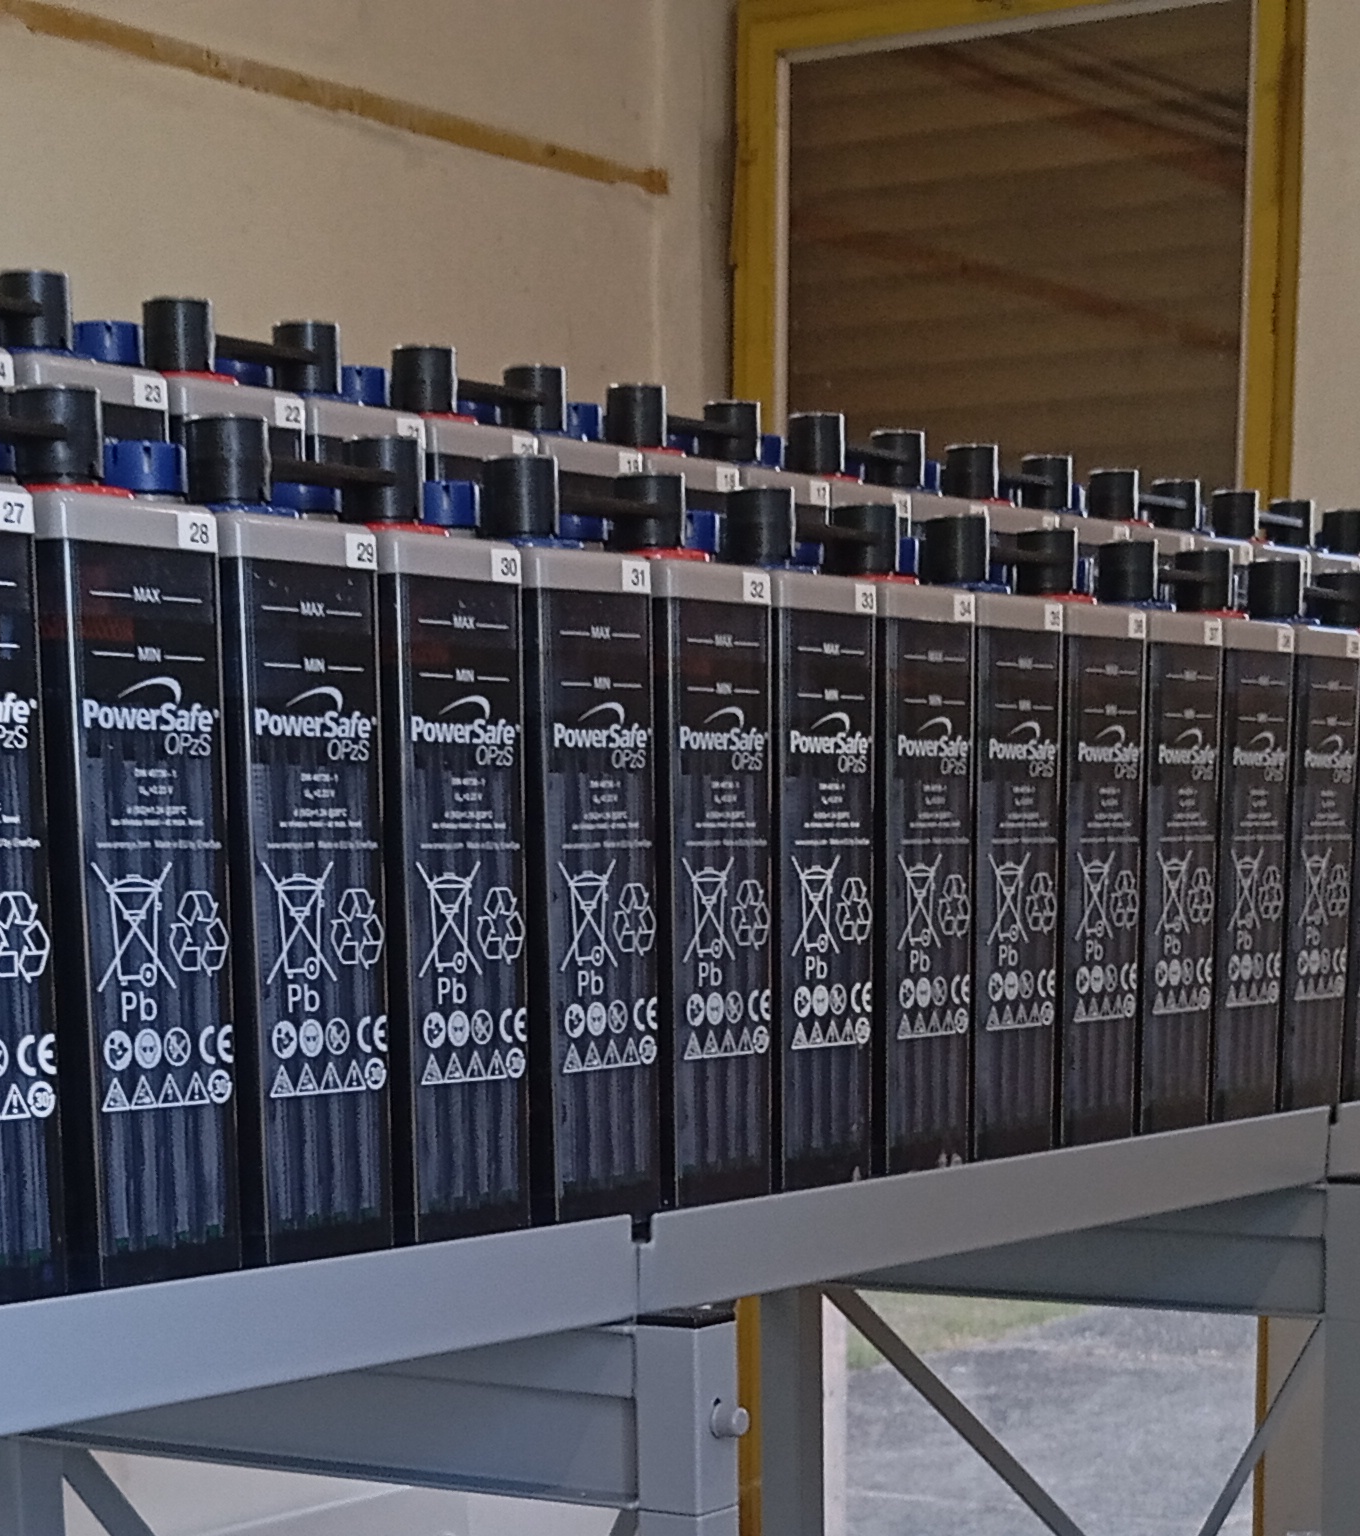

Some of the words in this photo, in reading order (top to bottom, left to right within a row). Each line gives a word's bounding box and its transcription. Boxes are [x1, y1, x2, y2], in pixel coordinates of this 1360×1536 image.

[144, 383, 162, 403] 23
[285, 405, 302, 424] 22
[2, 501, 25, 525] 27
[188, 521, 210, 545] 28
[356, 541, 375, 563] 29
[500, 556, 518, 577] 30
[630, 568, 646, 588] 31
[132, 585, 162, 605] MAX
[750, 580, 765, 600] 32
[861, 590, 874, 610] 33
[299, 600, 326, 619] MAX
[958, 599, 973, 618] 34
[452, 614, 476, 631] MAX
[590, 625, 612, 641] MAX
[136, 646, 162, 664] MIN
[302, 656, 326, 674] MIN
[454, 668, 476, 684] MIN
[81, 698, 213, 733] PowerSafe
[254, 707, 372, 739] PowerSafe
[410, 715, 516, 745] PowerSafe
[553, 721, 648, 750] PowerSafe
[679, 724, 765, 753] PowerSafe
[164, 732, 212, 757] OPzS
[326, 739, 371, 762] OPzS
[475, 744, 515, 767] OPzS
[611, 749, 647, 770] OPzS
[731, 751, 763, 772] OPzS
[837, 754, 868, 775] OPzS
[909, 949, 931, 974] Pb
[998, 944, 1018, 967] Pb
[1085, 939, 1104, 962] Pb
[698, 961, 723, 987] Pb
[805, 956, 828, 981] Pb
[437, 976, 468, 1006] Pb
[576, 969, 604, 997] Pb
[119, 990, 158, 1024] Pb
[287, 983, 321, 1014] Pb
[747, 988, 772, 1023] CE
[850, 981, 873, 1014] CE
[498, 1006, 528, 1044] CE
[632, 995, 658, 1032] CE
[198, 1024, 234, 1065] CE
[356, 1014, 388, 1054] CE
[16, 1033, 58, 1078] CE
